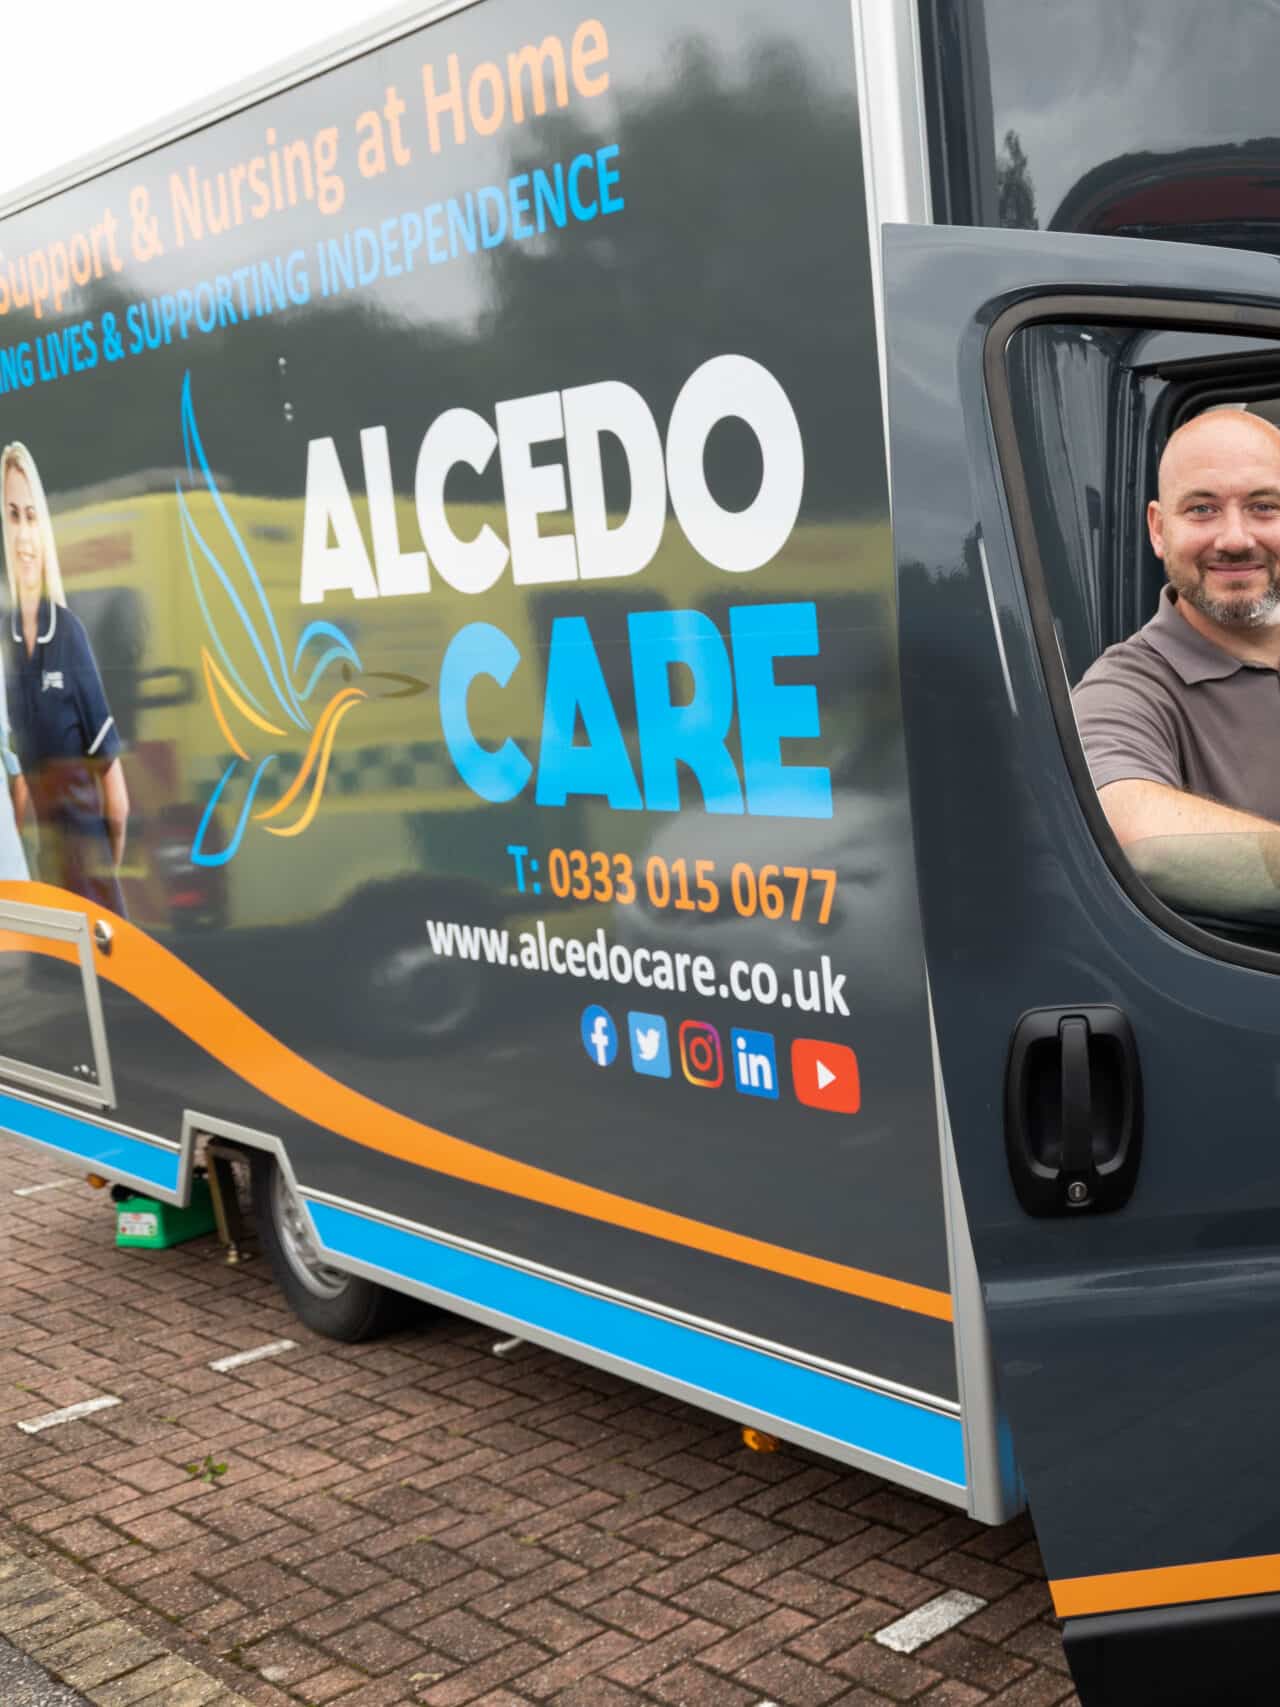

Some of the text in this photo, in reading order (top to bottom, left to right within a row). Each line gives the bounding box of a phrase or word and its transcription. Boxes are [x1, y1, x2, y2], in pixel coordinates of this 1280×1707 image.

[130, 186, 163, 261] &
[169, 127, 345, 248] Nursing
[357, 86, 410, 179] at
[422, 19, 610, 153] Home
[36, 320, 98, 381] LIVES
[101, 311, 125, 362] &
[127, 250, 309, 353] SUPPORTING
[320, 144, 625, 296] INDEPENDENCE
[300, 354, 804, 603] ALCEDO
[439, 602, 833, 818] CARE
[426, 920, 850, 1016] www.alcedocare.co.uk
[507, 845, 836, 924] T: 0333 015 0677
